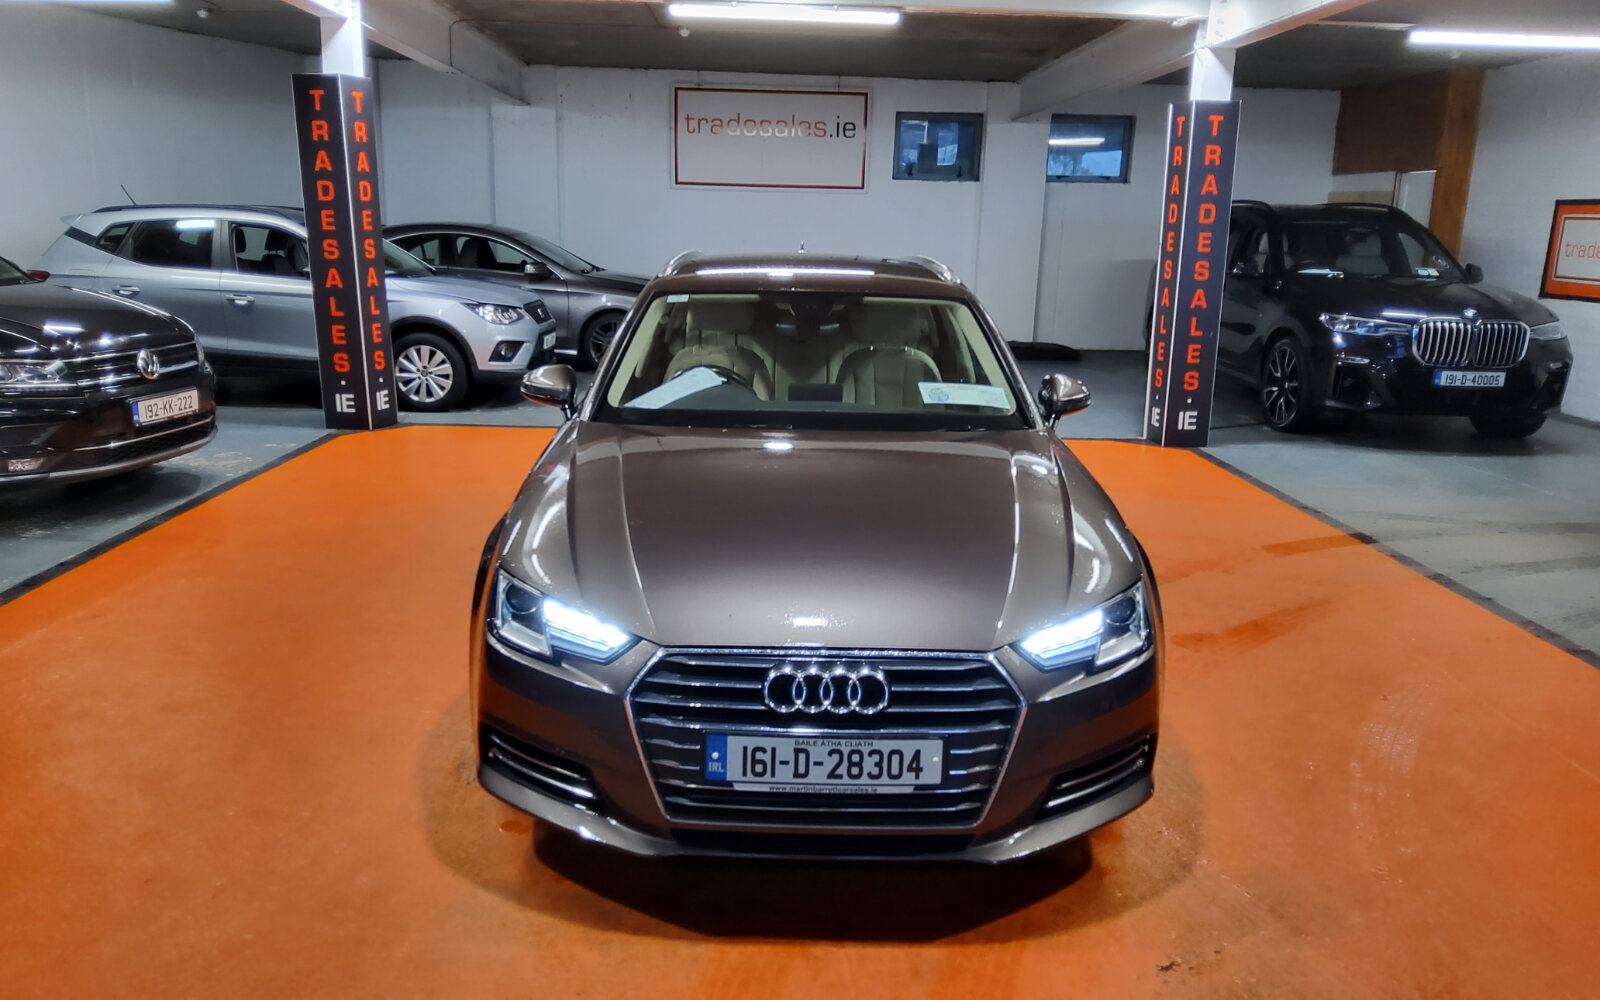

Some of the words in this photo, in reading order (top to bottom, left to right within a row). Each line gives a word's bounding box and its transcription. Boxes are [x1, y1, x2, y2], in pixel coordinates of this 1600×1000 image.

[685, 112, 857, 139] tradesales.ie
[1445, 374, 1500, 385] 191-D-40005
[144, 394, 193, 419] 192-KK-222
[794, 739, 818, 747] BAILE
[844, 740, 874, 748] CLIATH
[708, 761, 725, 773] IRL
[742, 745, 924, 781] 161-D-28304
